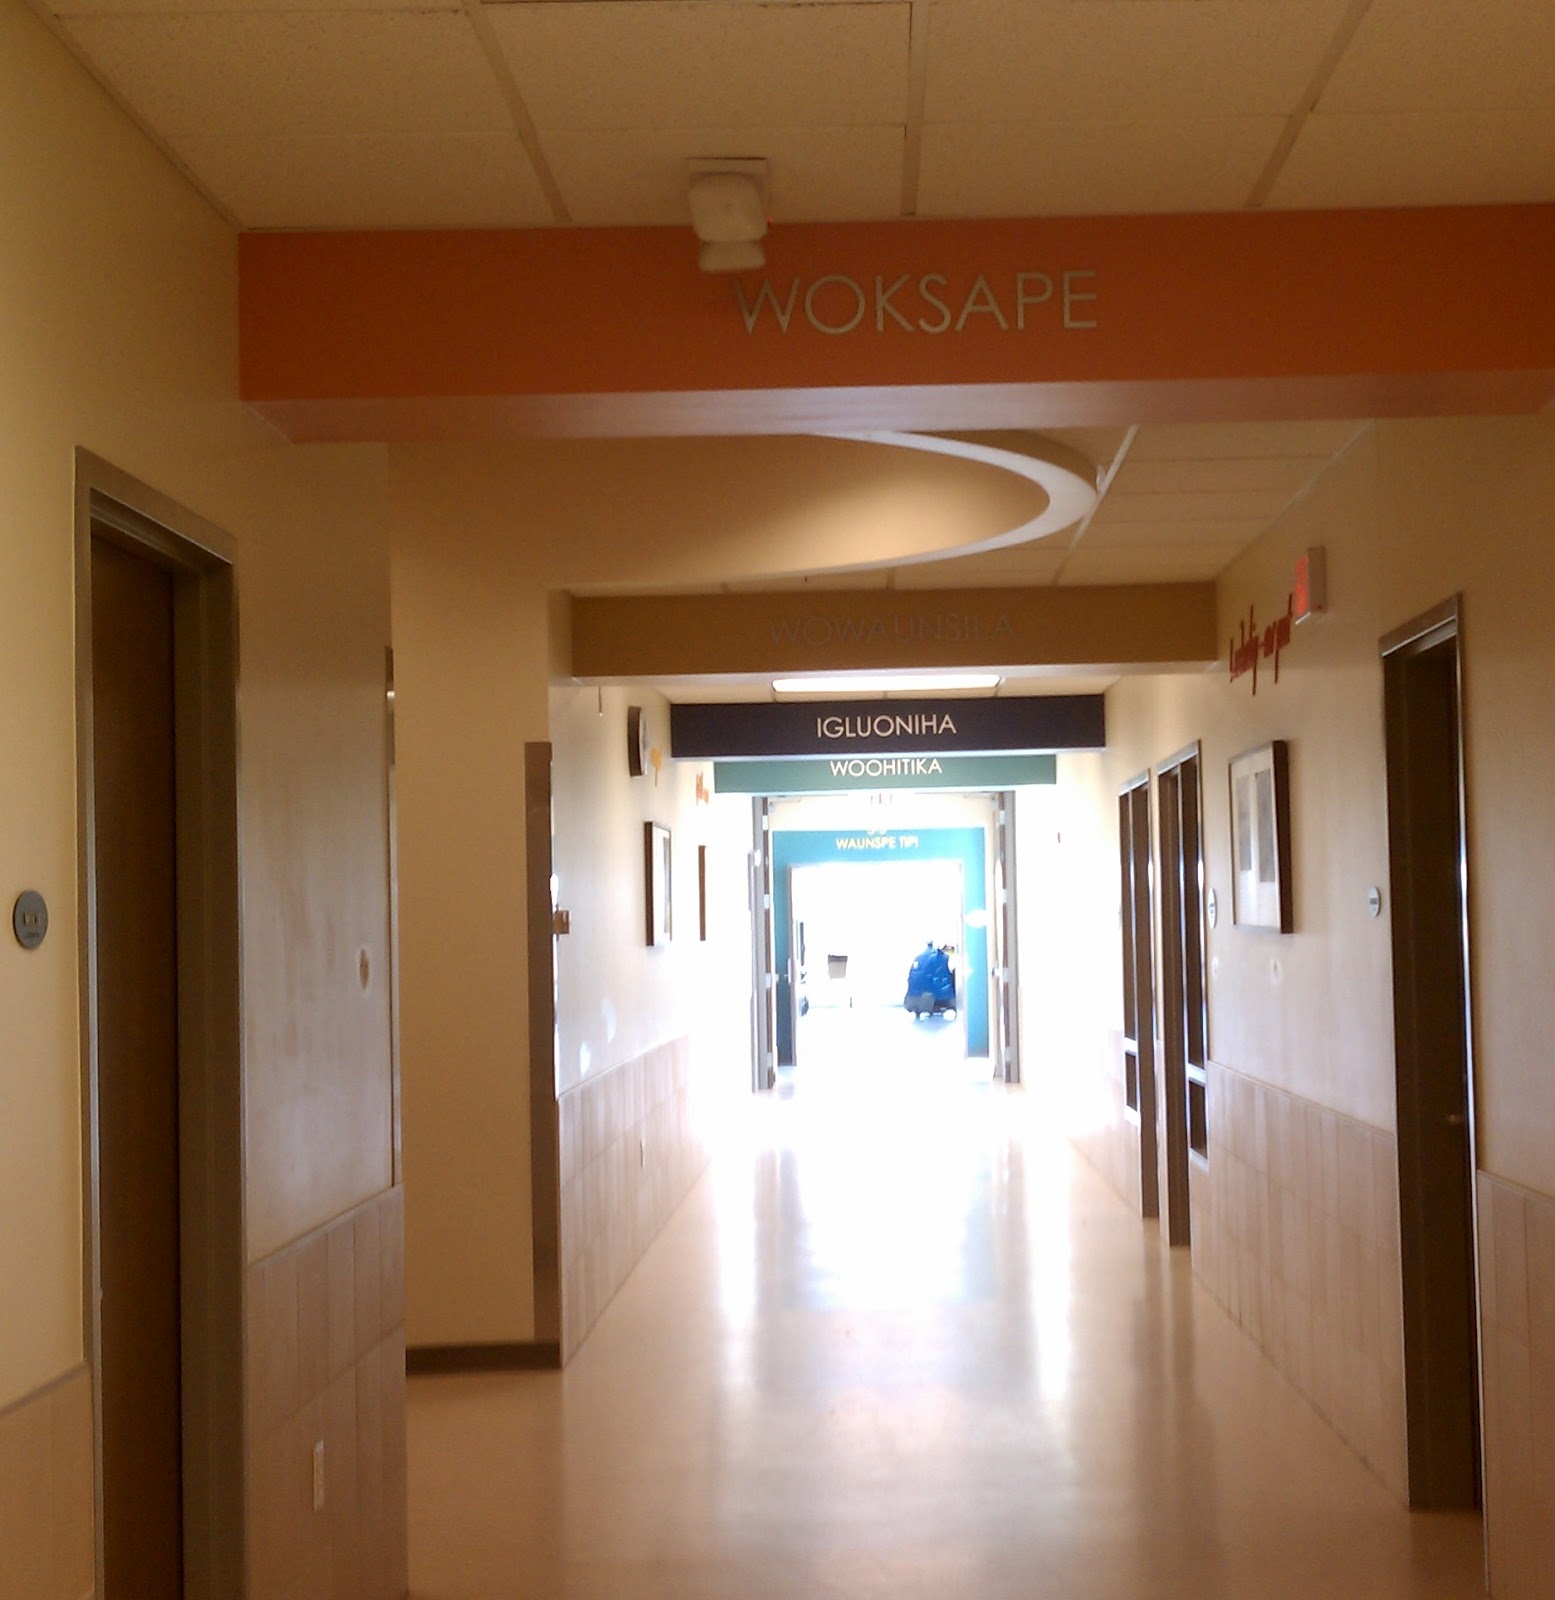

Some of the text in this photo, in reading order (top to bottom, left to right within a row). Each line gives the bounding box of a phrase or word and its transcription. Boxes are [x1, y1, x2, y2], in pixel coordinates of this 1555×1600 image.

[734, 270, 1098, 335] WOKSAPE
[768, 614, 1016, 646] WOWAUNSILA
[816, 714, 957, 739] IGLUONIHA
[830, 758, 943, 777] WOOHITIKA
[835, 835, 919, 849] WAUNSPE TIPI
